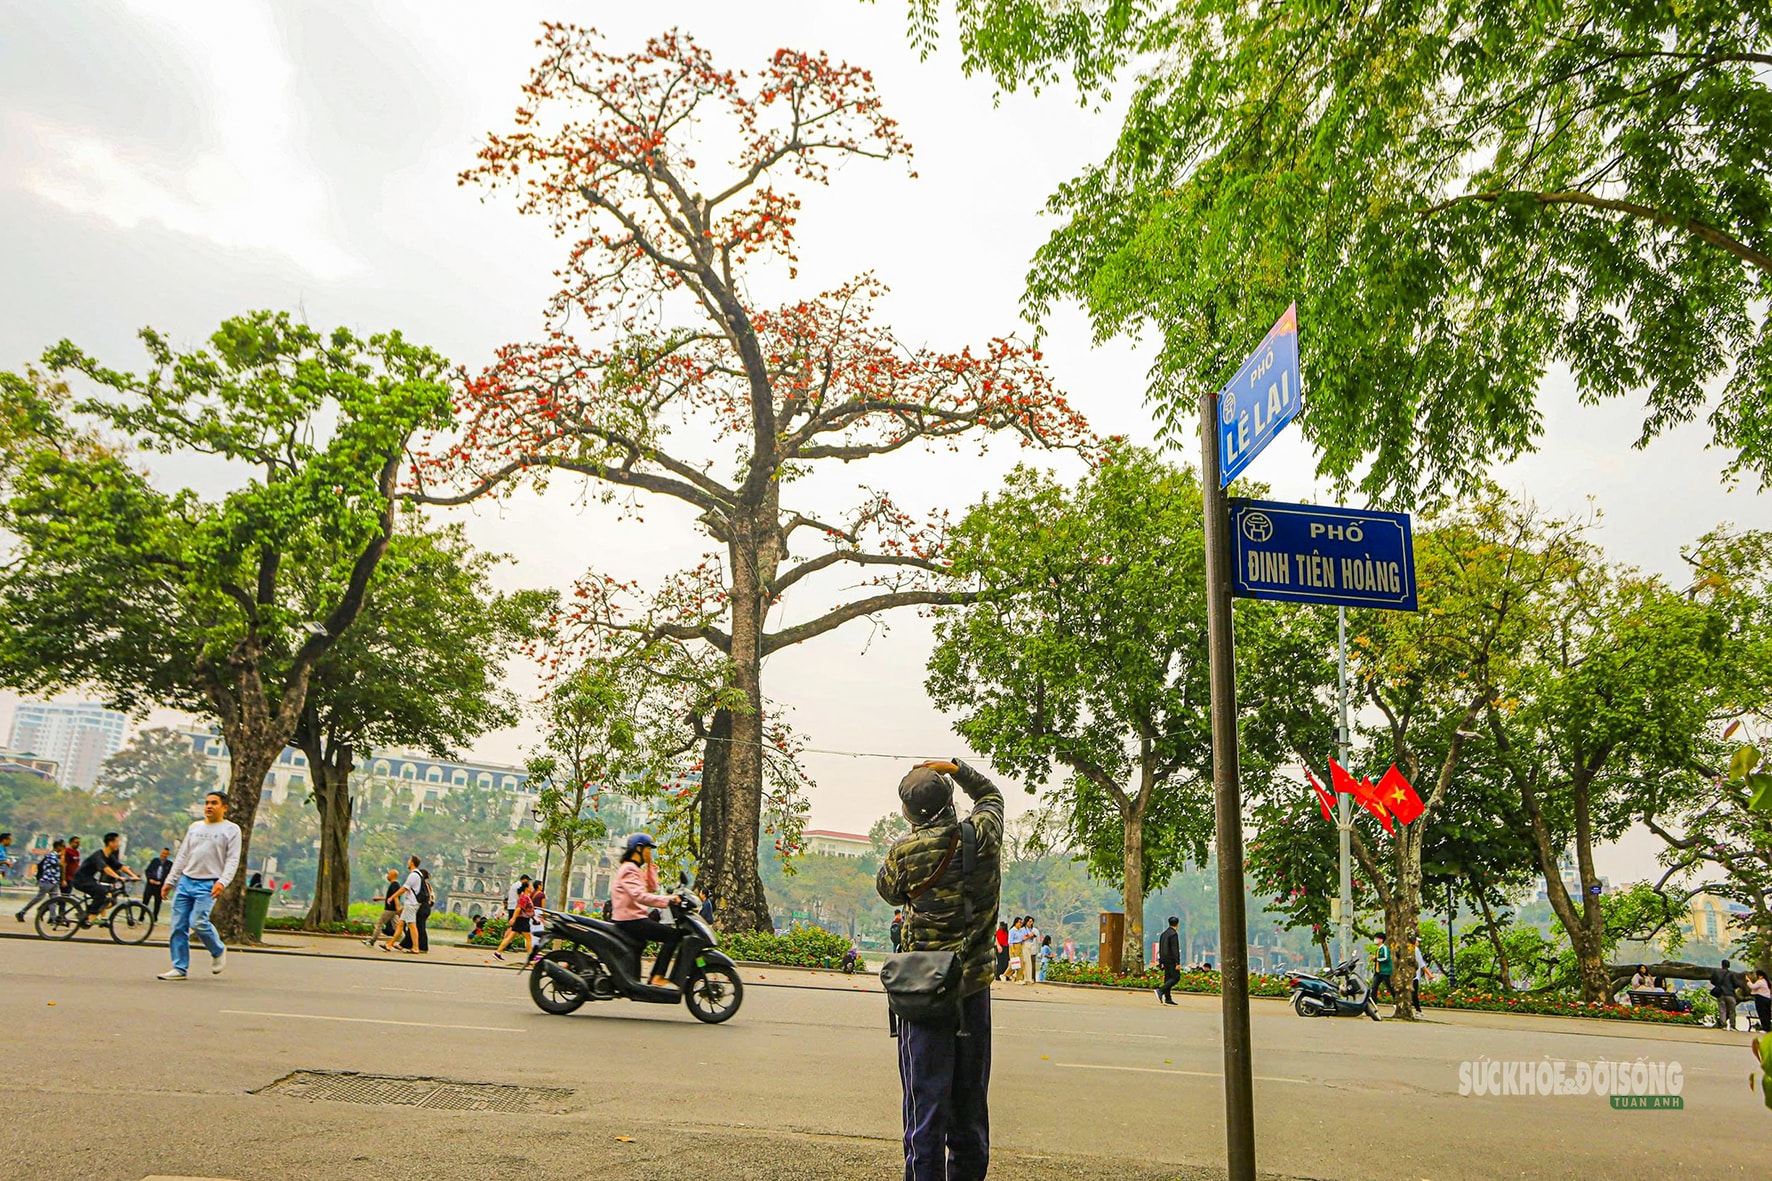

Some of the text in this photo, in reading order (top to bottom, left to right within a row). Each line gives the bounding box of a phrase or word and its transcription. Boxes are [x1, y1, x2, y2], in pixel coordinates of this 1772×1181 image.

[1250, 341, 1274, 389] PHỐ
[1226, 369, 1289, 465] LÊ LAI
[1310, 520, 1365, 542] PHỐ
[1248, 549, 1401, 593] ĐINH TIÊN HOÀNG
